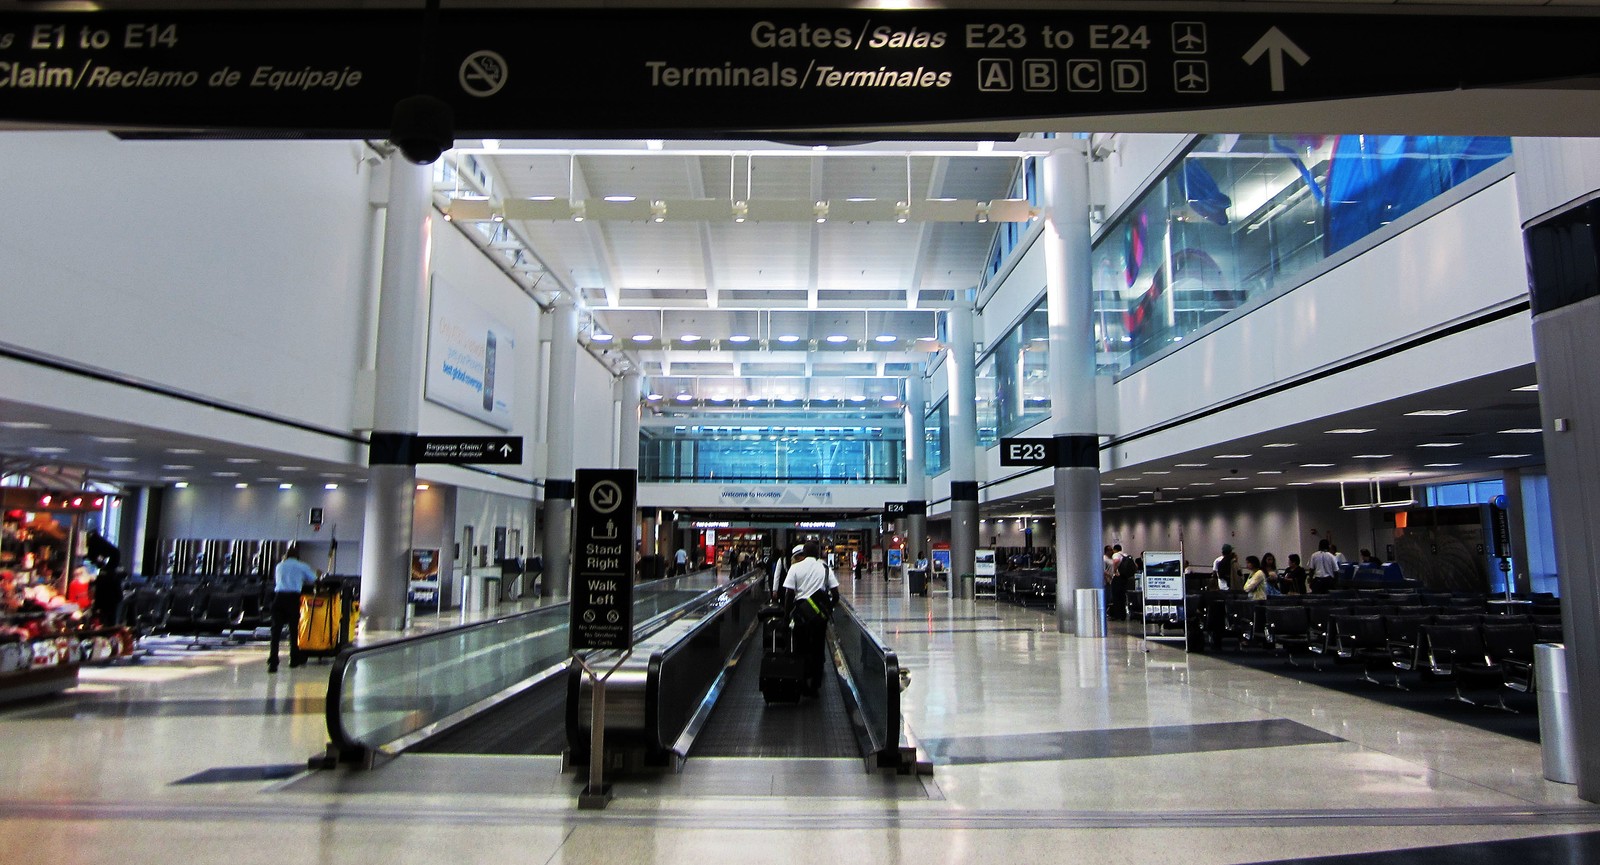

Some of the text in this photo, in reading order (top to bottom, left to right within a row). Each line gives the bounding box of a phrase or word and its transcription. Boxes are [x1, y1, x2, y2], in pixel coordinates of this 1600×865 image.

[31, 26, 65, 49] E1
[80, 28, 110, 49] to
[124, 23, 179, 48] E14
[965, 24, 1027, 50] E23
[1041, 26, 1074, 49] to
[1089, 25, 1151, 50] E24
[208, 67, 241, 87] de
[250, 66, 363, 92] Equipaje
[985, 63, 1008, 88] A
[1030, 62, 1050, 87] B
[1073, 62, 1096, 88] C
[1118, 62, 1141, 88] D
[1010, 444, 1046, 460] E23
[888, 504, 904, 512] E24
[586, 543, 622, 555] Stand
[587, 557, 619, 571] Right
[588, 580, 617, 592] Walk
[589, 594, 614, 605] Left
